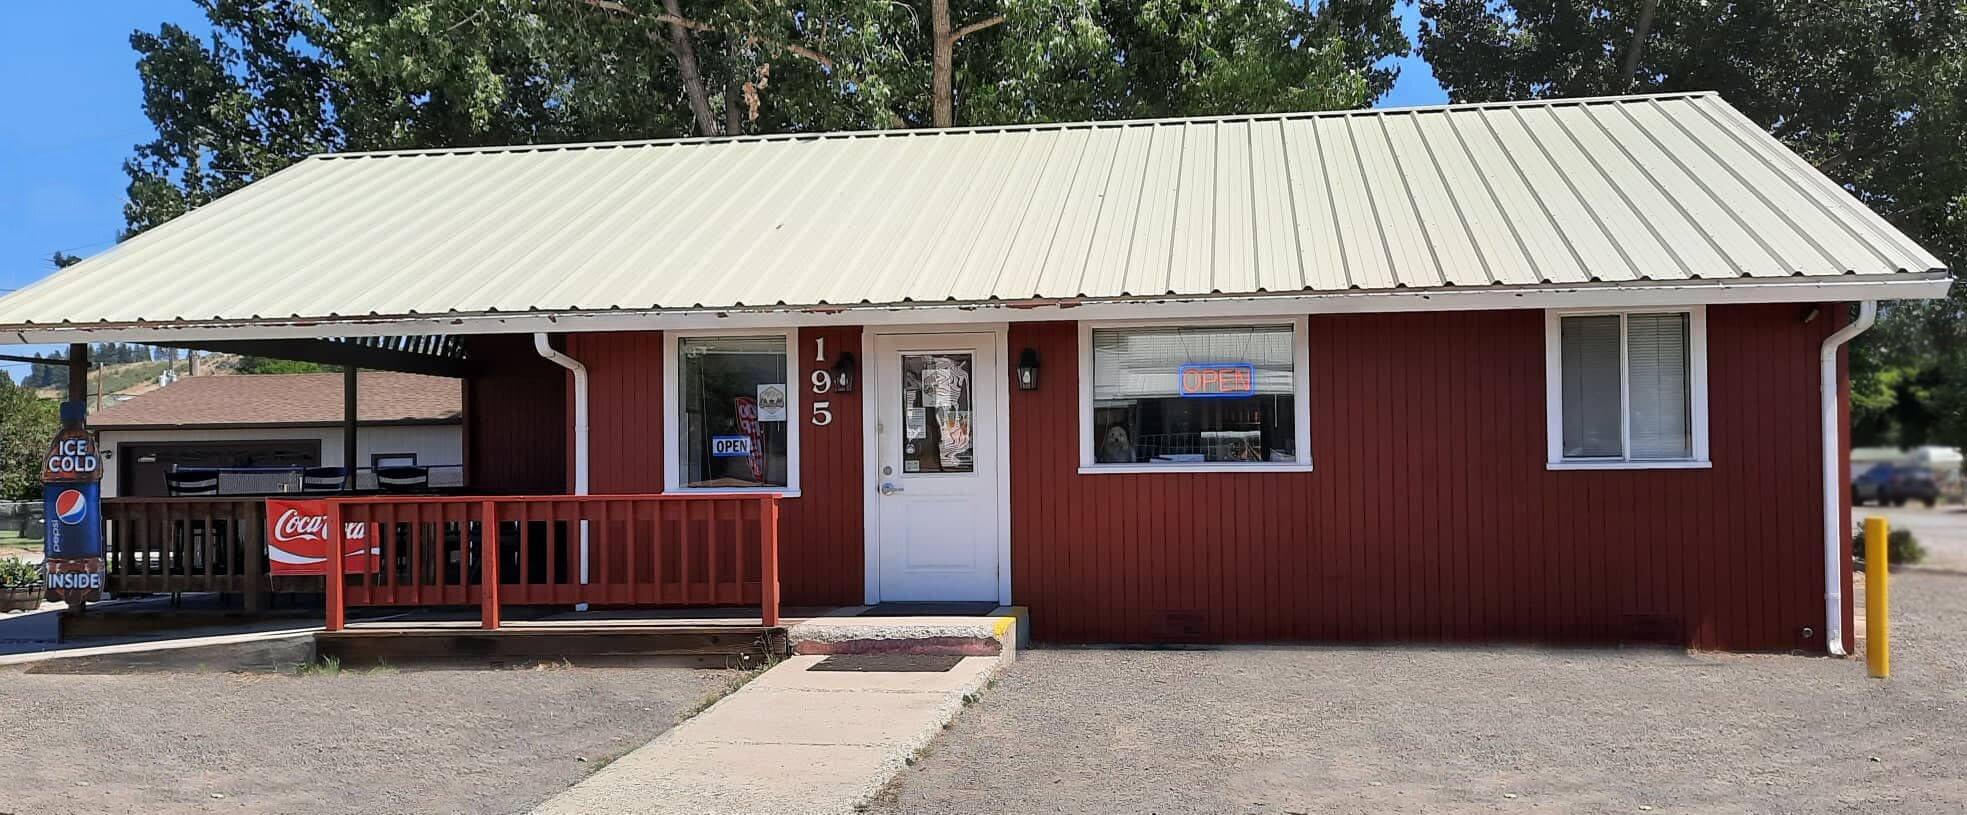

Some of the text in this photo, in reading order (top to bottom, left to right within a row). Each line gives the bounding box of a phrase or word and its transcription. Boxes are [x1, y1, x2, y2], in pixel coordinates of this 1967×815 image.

[811, 337, 832, 425] 195
[1183, 368, 1251, 392] OPEN
[59, 440, 87, 456] ICE
[716, 440, 748, 453] OPEN
[48, 456, 97, 472] COLD
[51, 519, 61, 553] pepsi
[48, 573, 101, 589] INSIDE
